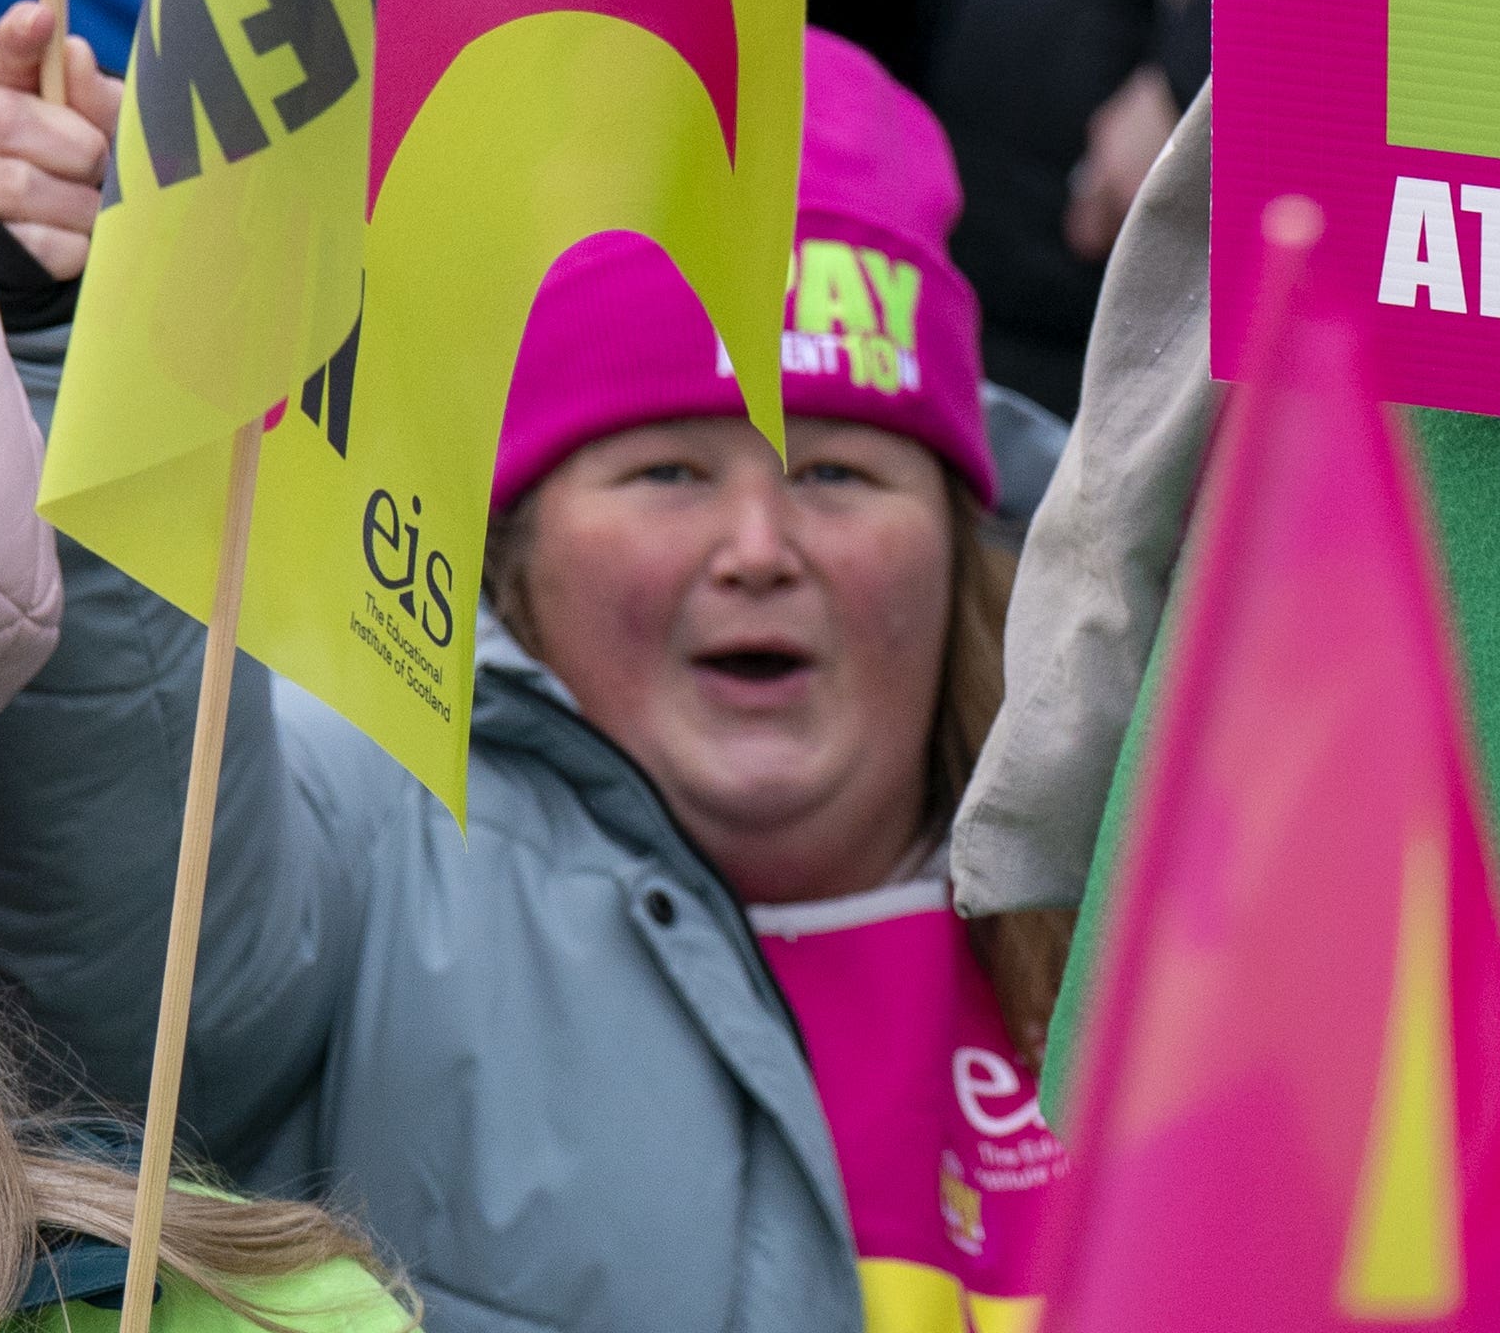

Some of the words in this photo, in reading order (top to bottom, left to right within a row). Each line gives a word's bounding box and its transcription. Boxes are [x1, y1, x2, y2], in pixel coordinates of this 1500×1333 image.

[787, 240, 922, 350] AY
[363, 488, 453, 648] eis
[350, 611, 393, 667] Institute
[394, 656, 405, 680] of
[406, 668, 451, 724] Scotland
[365, 591, 385, 626] The
[386, 614, 443, 686] Educational
